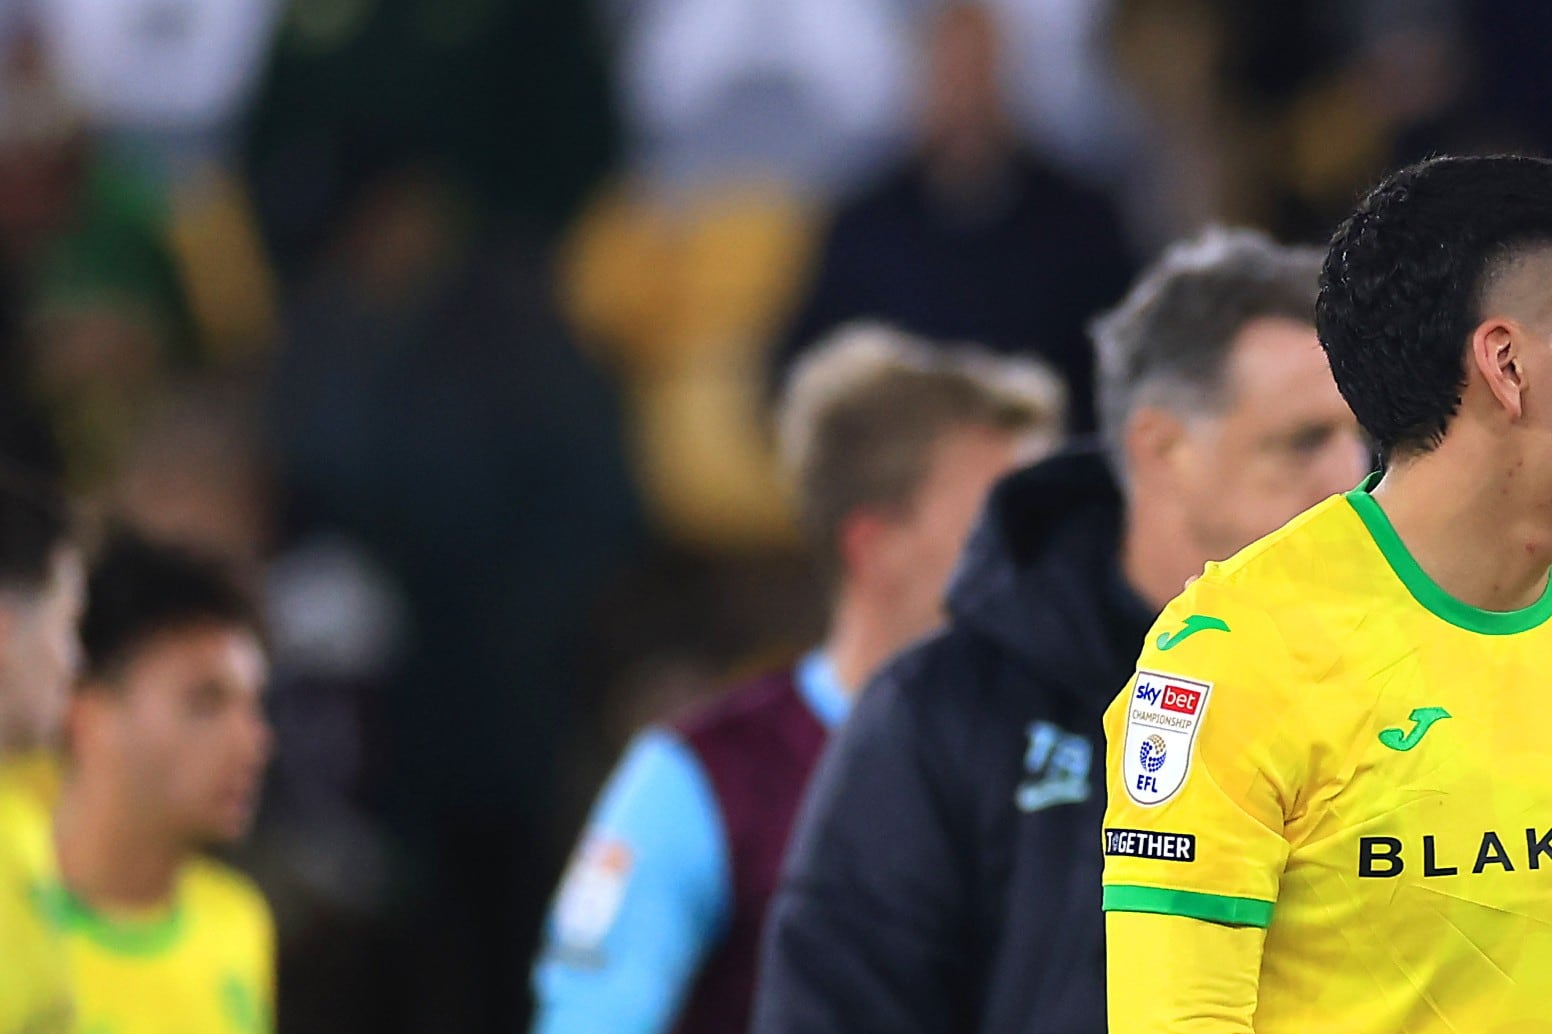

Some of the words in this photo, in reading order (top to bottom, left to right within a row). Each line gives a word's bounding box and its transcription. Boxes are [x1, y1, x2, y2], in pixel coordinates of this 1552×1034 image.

[1136, 682, 1162, 706] sky
[1164, 687, 1196, 710] bet
[1132, 709, 1192, 730] CHAMPIONSHIP
[1136, 774, 1158, 793] EFL
